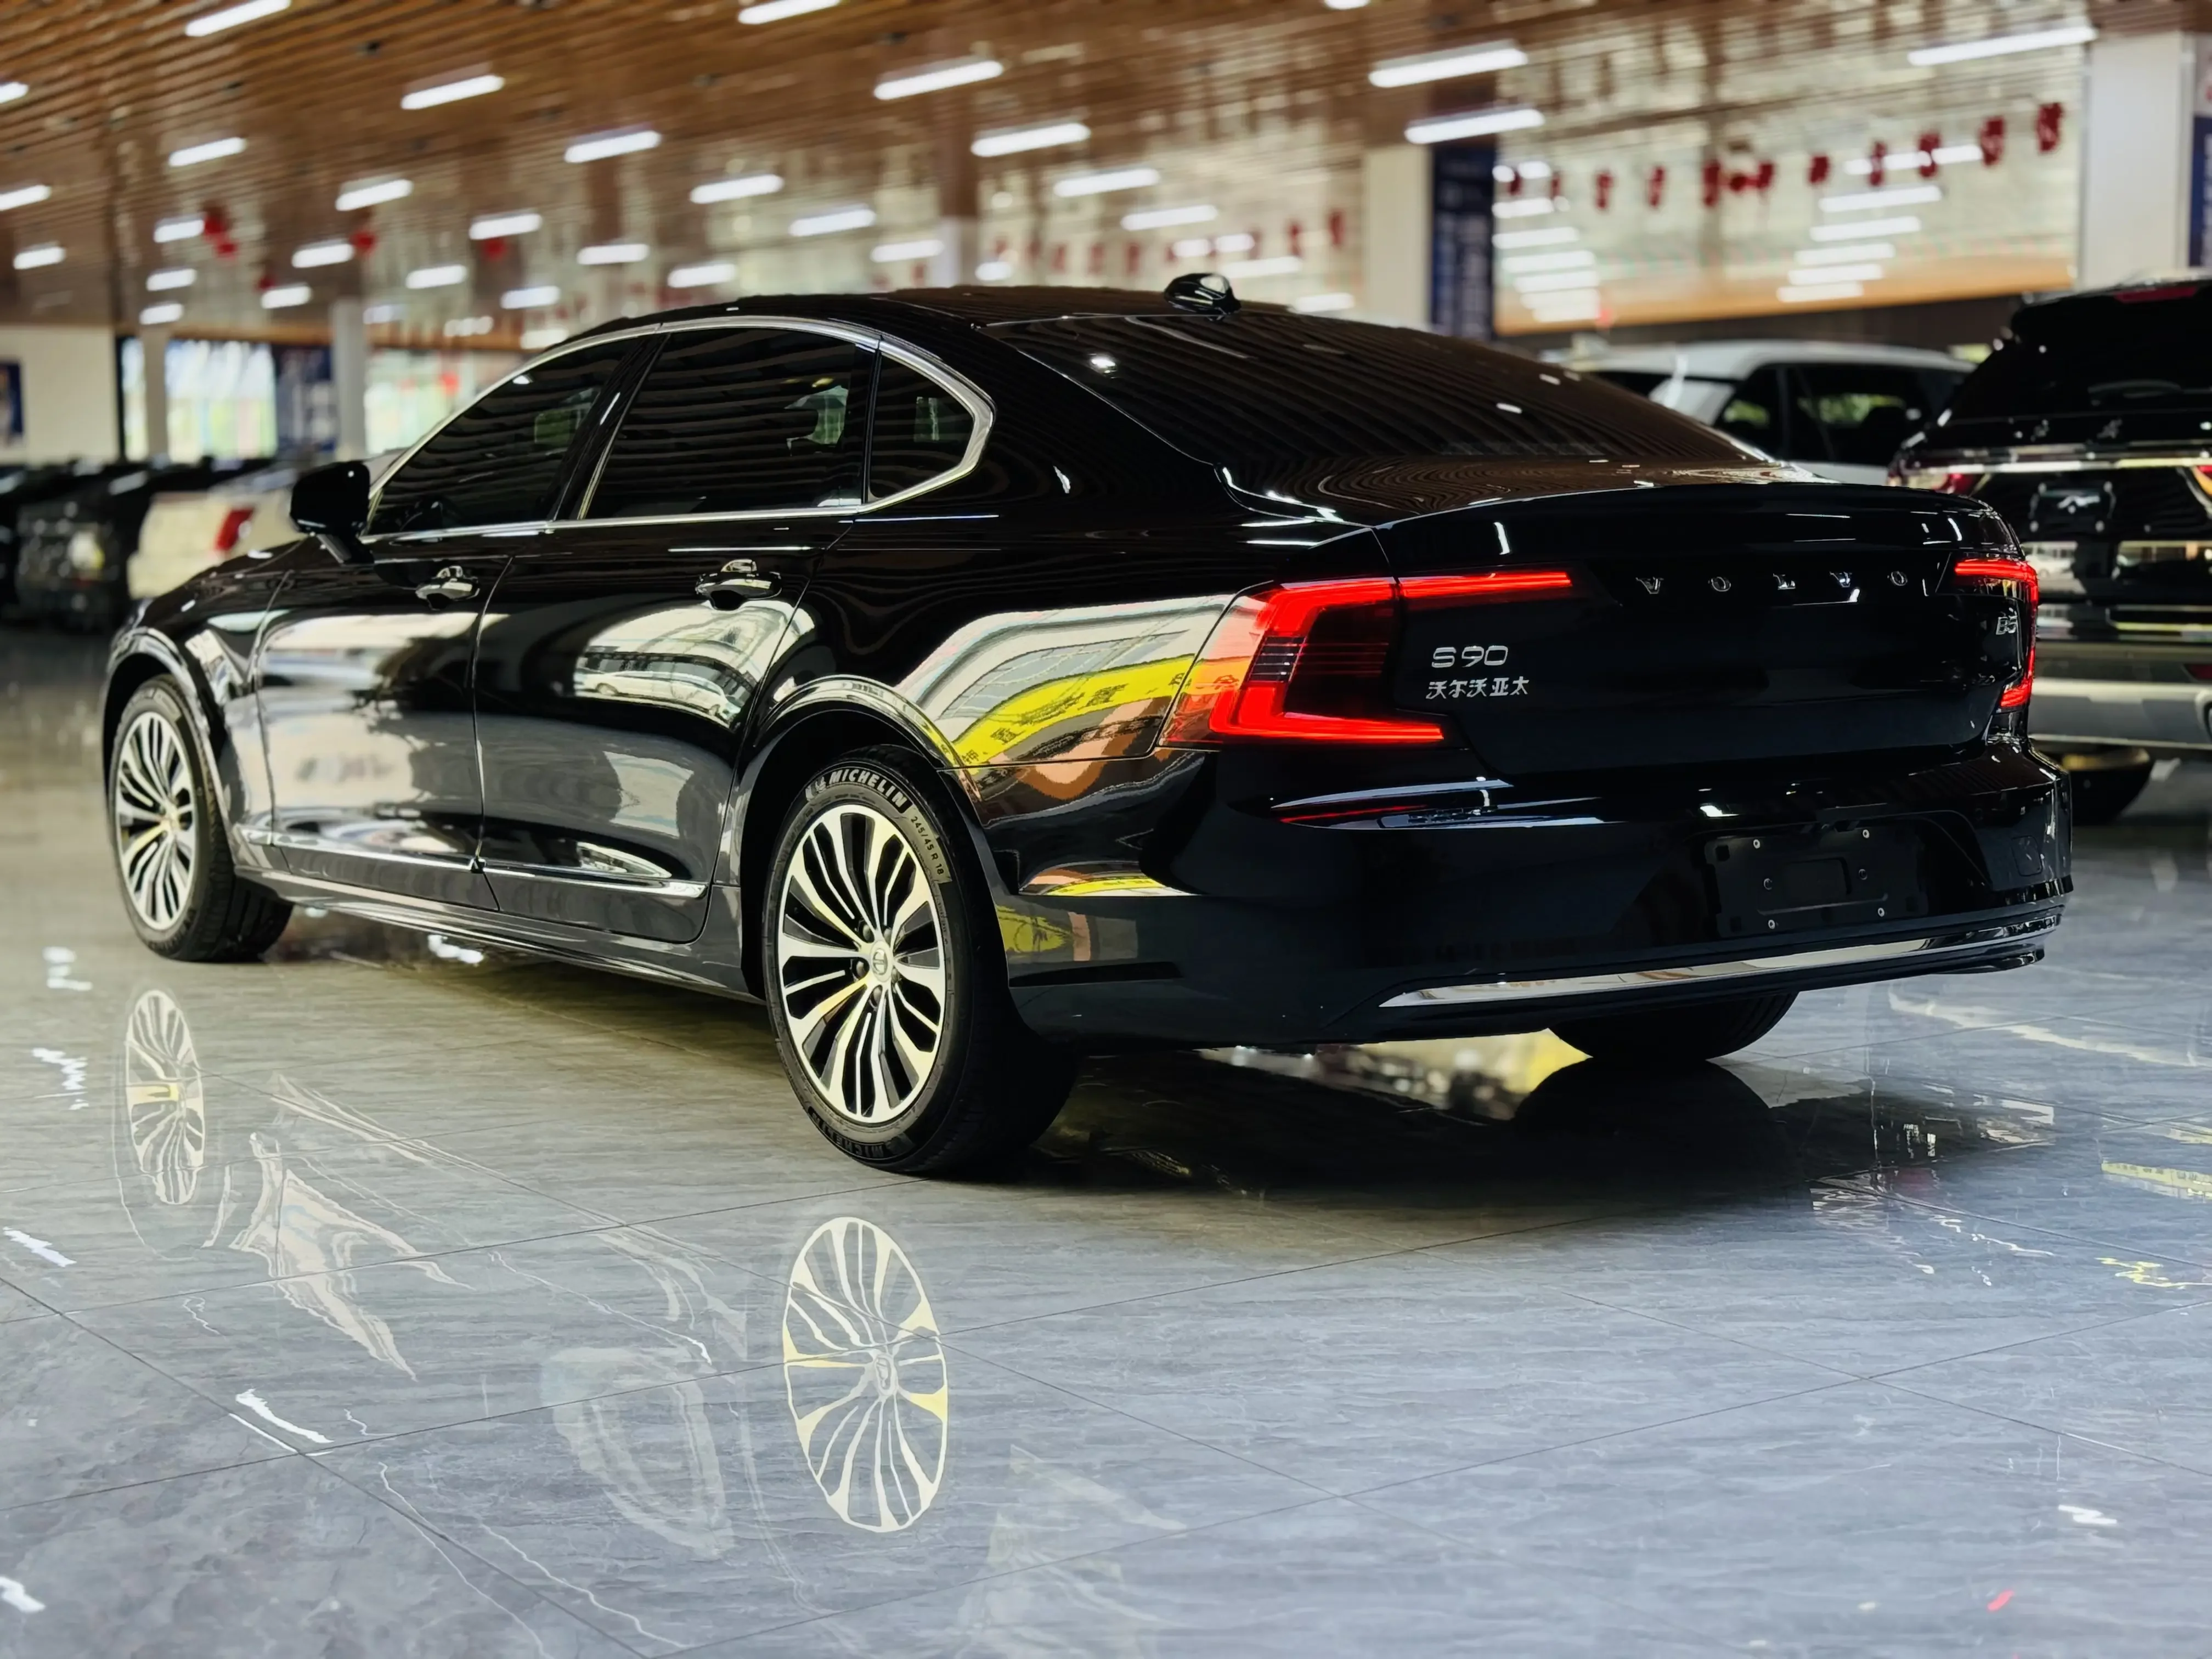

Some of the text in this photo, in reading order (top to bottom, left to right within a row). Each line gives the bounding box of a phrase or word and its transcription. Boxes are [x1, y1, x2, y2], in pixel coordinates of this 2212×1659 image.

[1635, 571, 1908, 594] VOLVO
[1995, 615, 2018, 635] B5
[1431, 645, 1509, 668] S90
[1425, 676, 1530, 699] 沃尔沃亚太
[828, 768, 907, 808] MICHELIN
[910, 816, 935, 851] 245/45
[935, 863, 945, 876] 18
